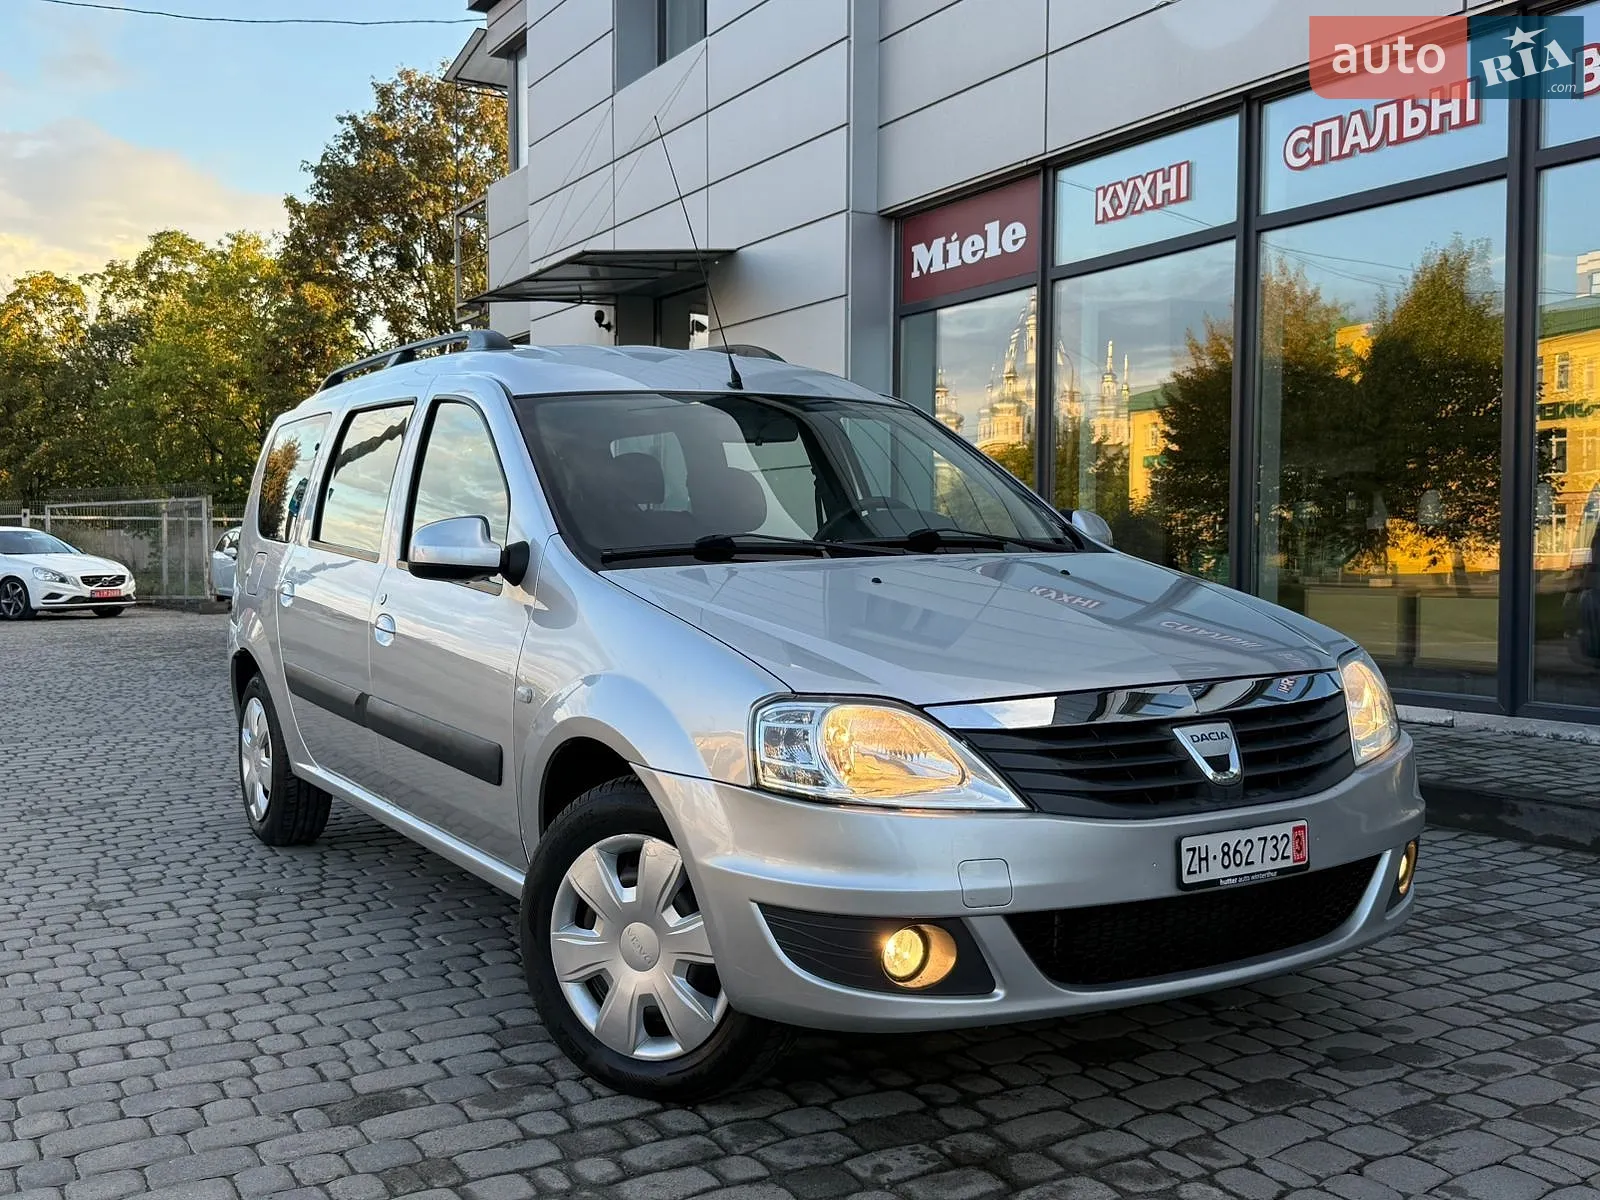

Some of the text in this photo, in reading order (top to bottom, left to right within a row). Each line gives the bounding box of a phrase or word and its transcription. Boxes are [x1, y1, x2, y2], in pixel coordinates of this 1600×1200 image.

[1283, 76, 1481, 171] СПАЛЬНІ
[1095, 160, 1191, 225] КУХНІ
[911, 220, 1027, 279] Miele
[1189, 730, 1230, 744] DACIA
